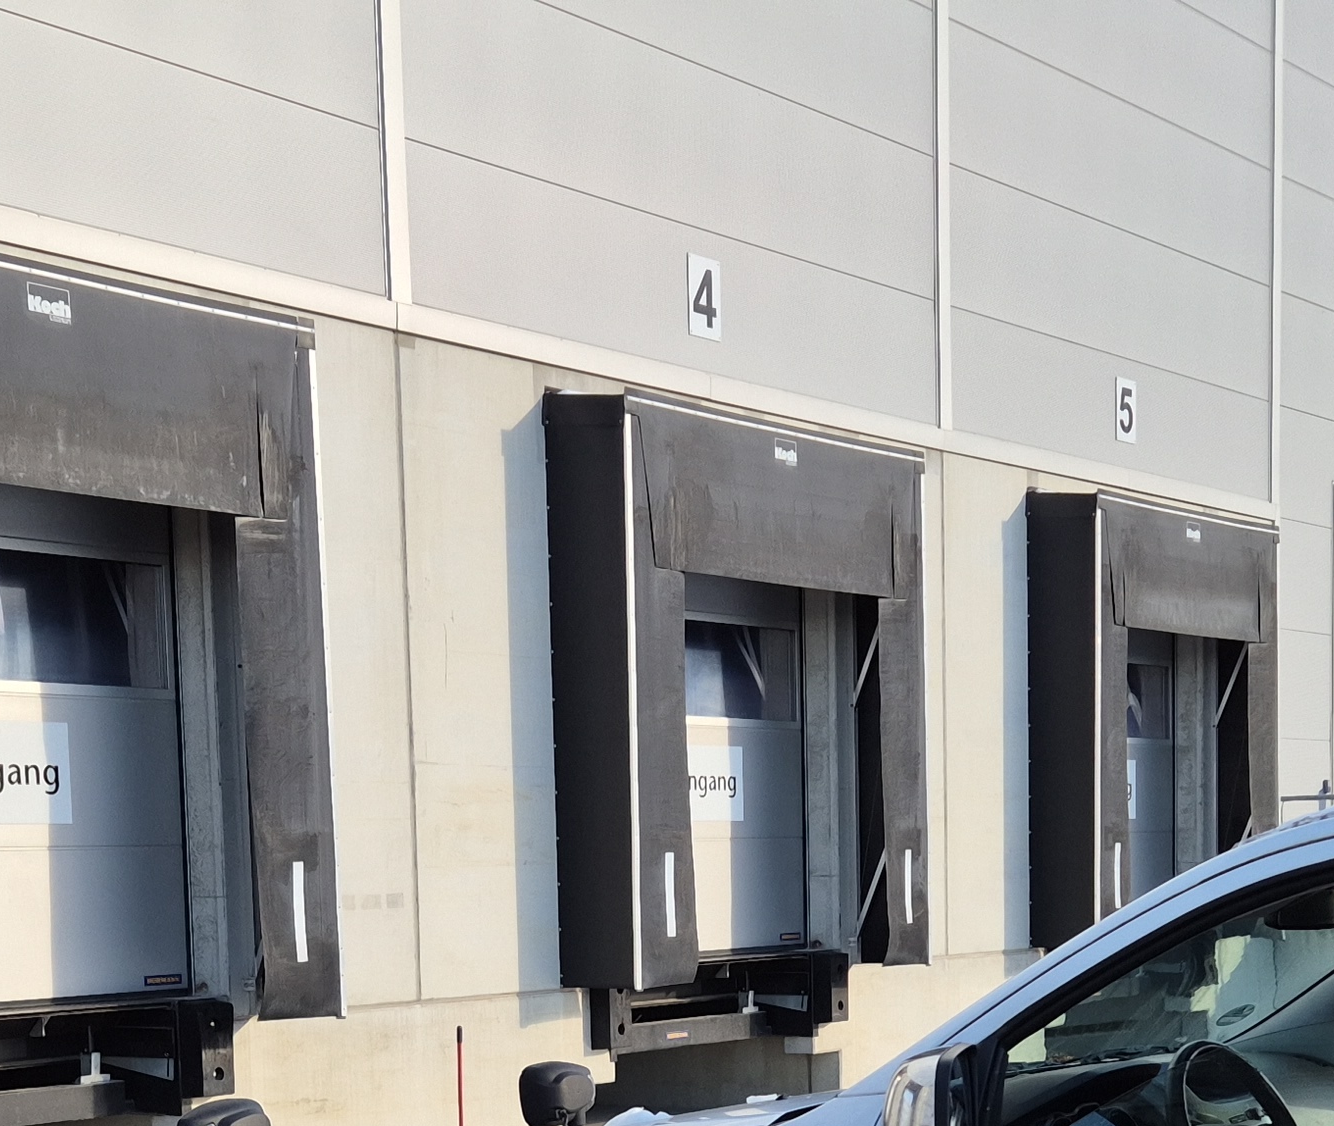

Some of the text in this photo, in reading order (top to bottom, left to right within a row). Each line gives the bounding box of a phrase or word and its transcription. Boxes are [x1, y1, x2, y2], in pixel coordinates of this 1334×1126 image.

[693, 269, 717, 328] 4
[1120, 387, 1133, 433] 5
[688, 775, 737, 798] ngang
